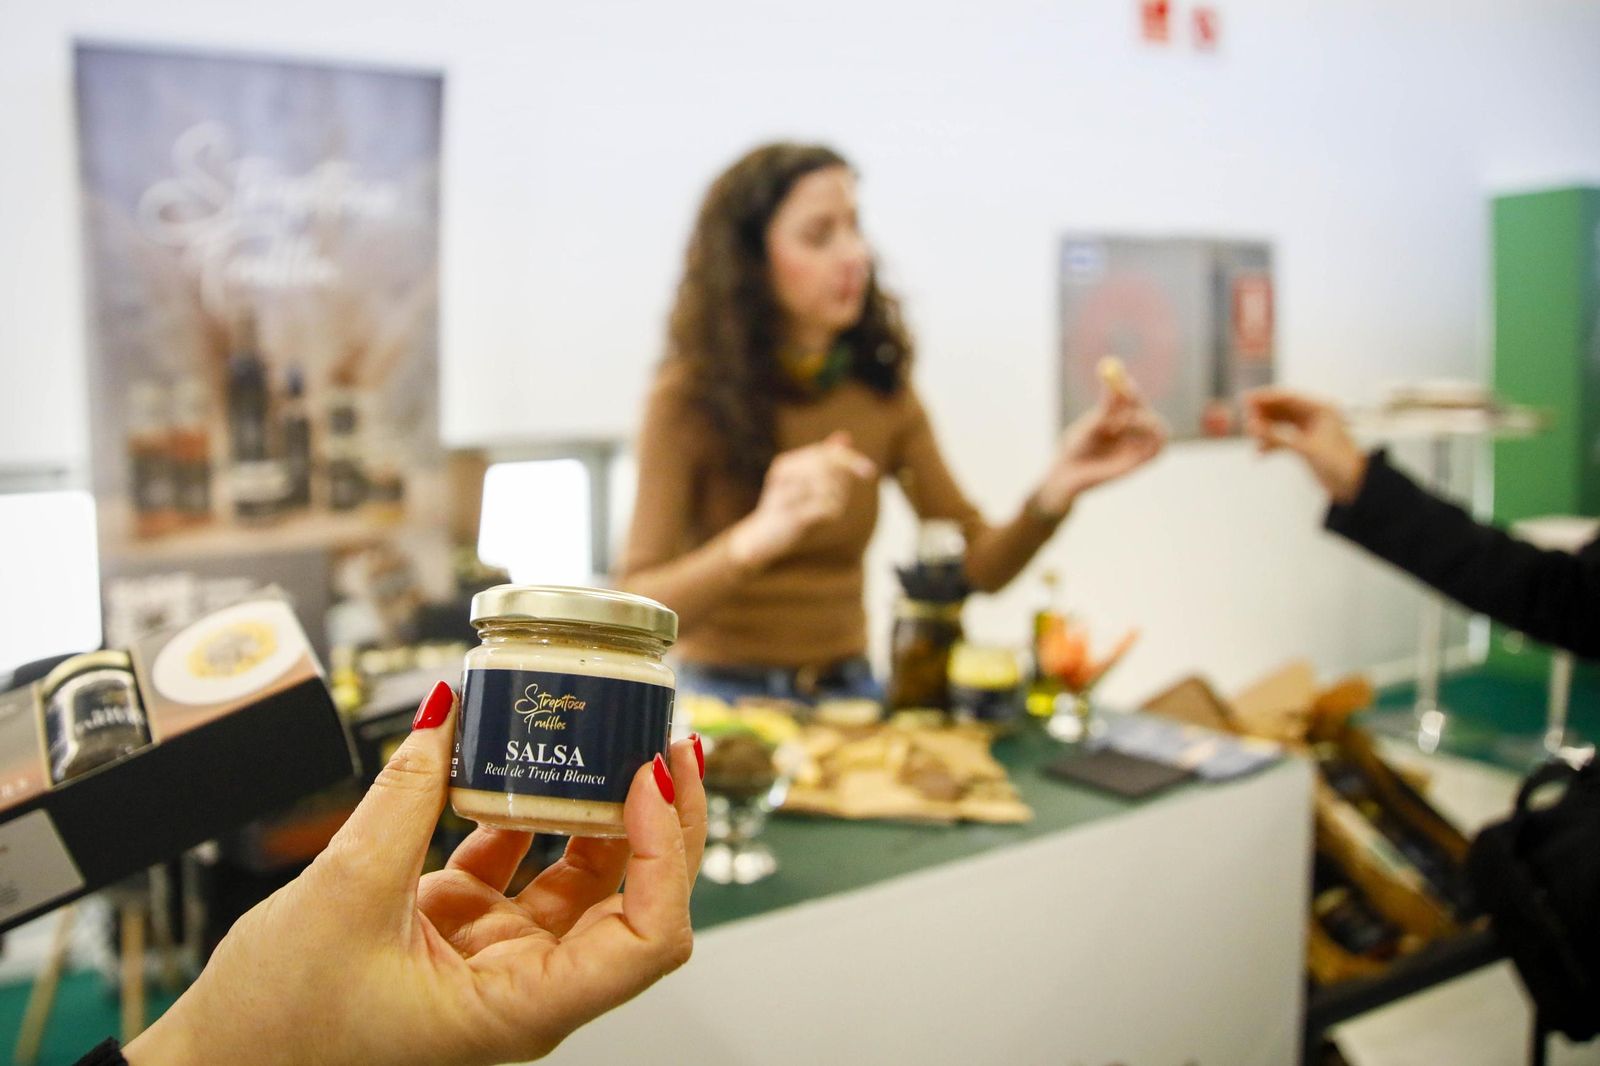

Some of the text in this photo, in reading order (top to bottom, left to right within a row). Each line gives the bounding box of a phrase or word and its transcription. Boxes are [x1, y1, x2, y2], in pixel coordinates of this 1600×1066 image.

[514, 683, 587, 714] Strepitosa
[523, 709, 567, 735] Truffles
[505, 740, 585, 767] SALSA
[484, 762, 606, 786] Real de Trufa Blanca
